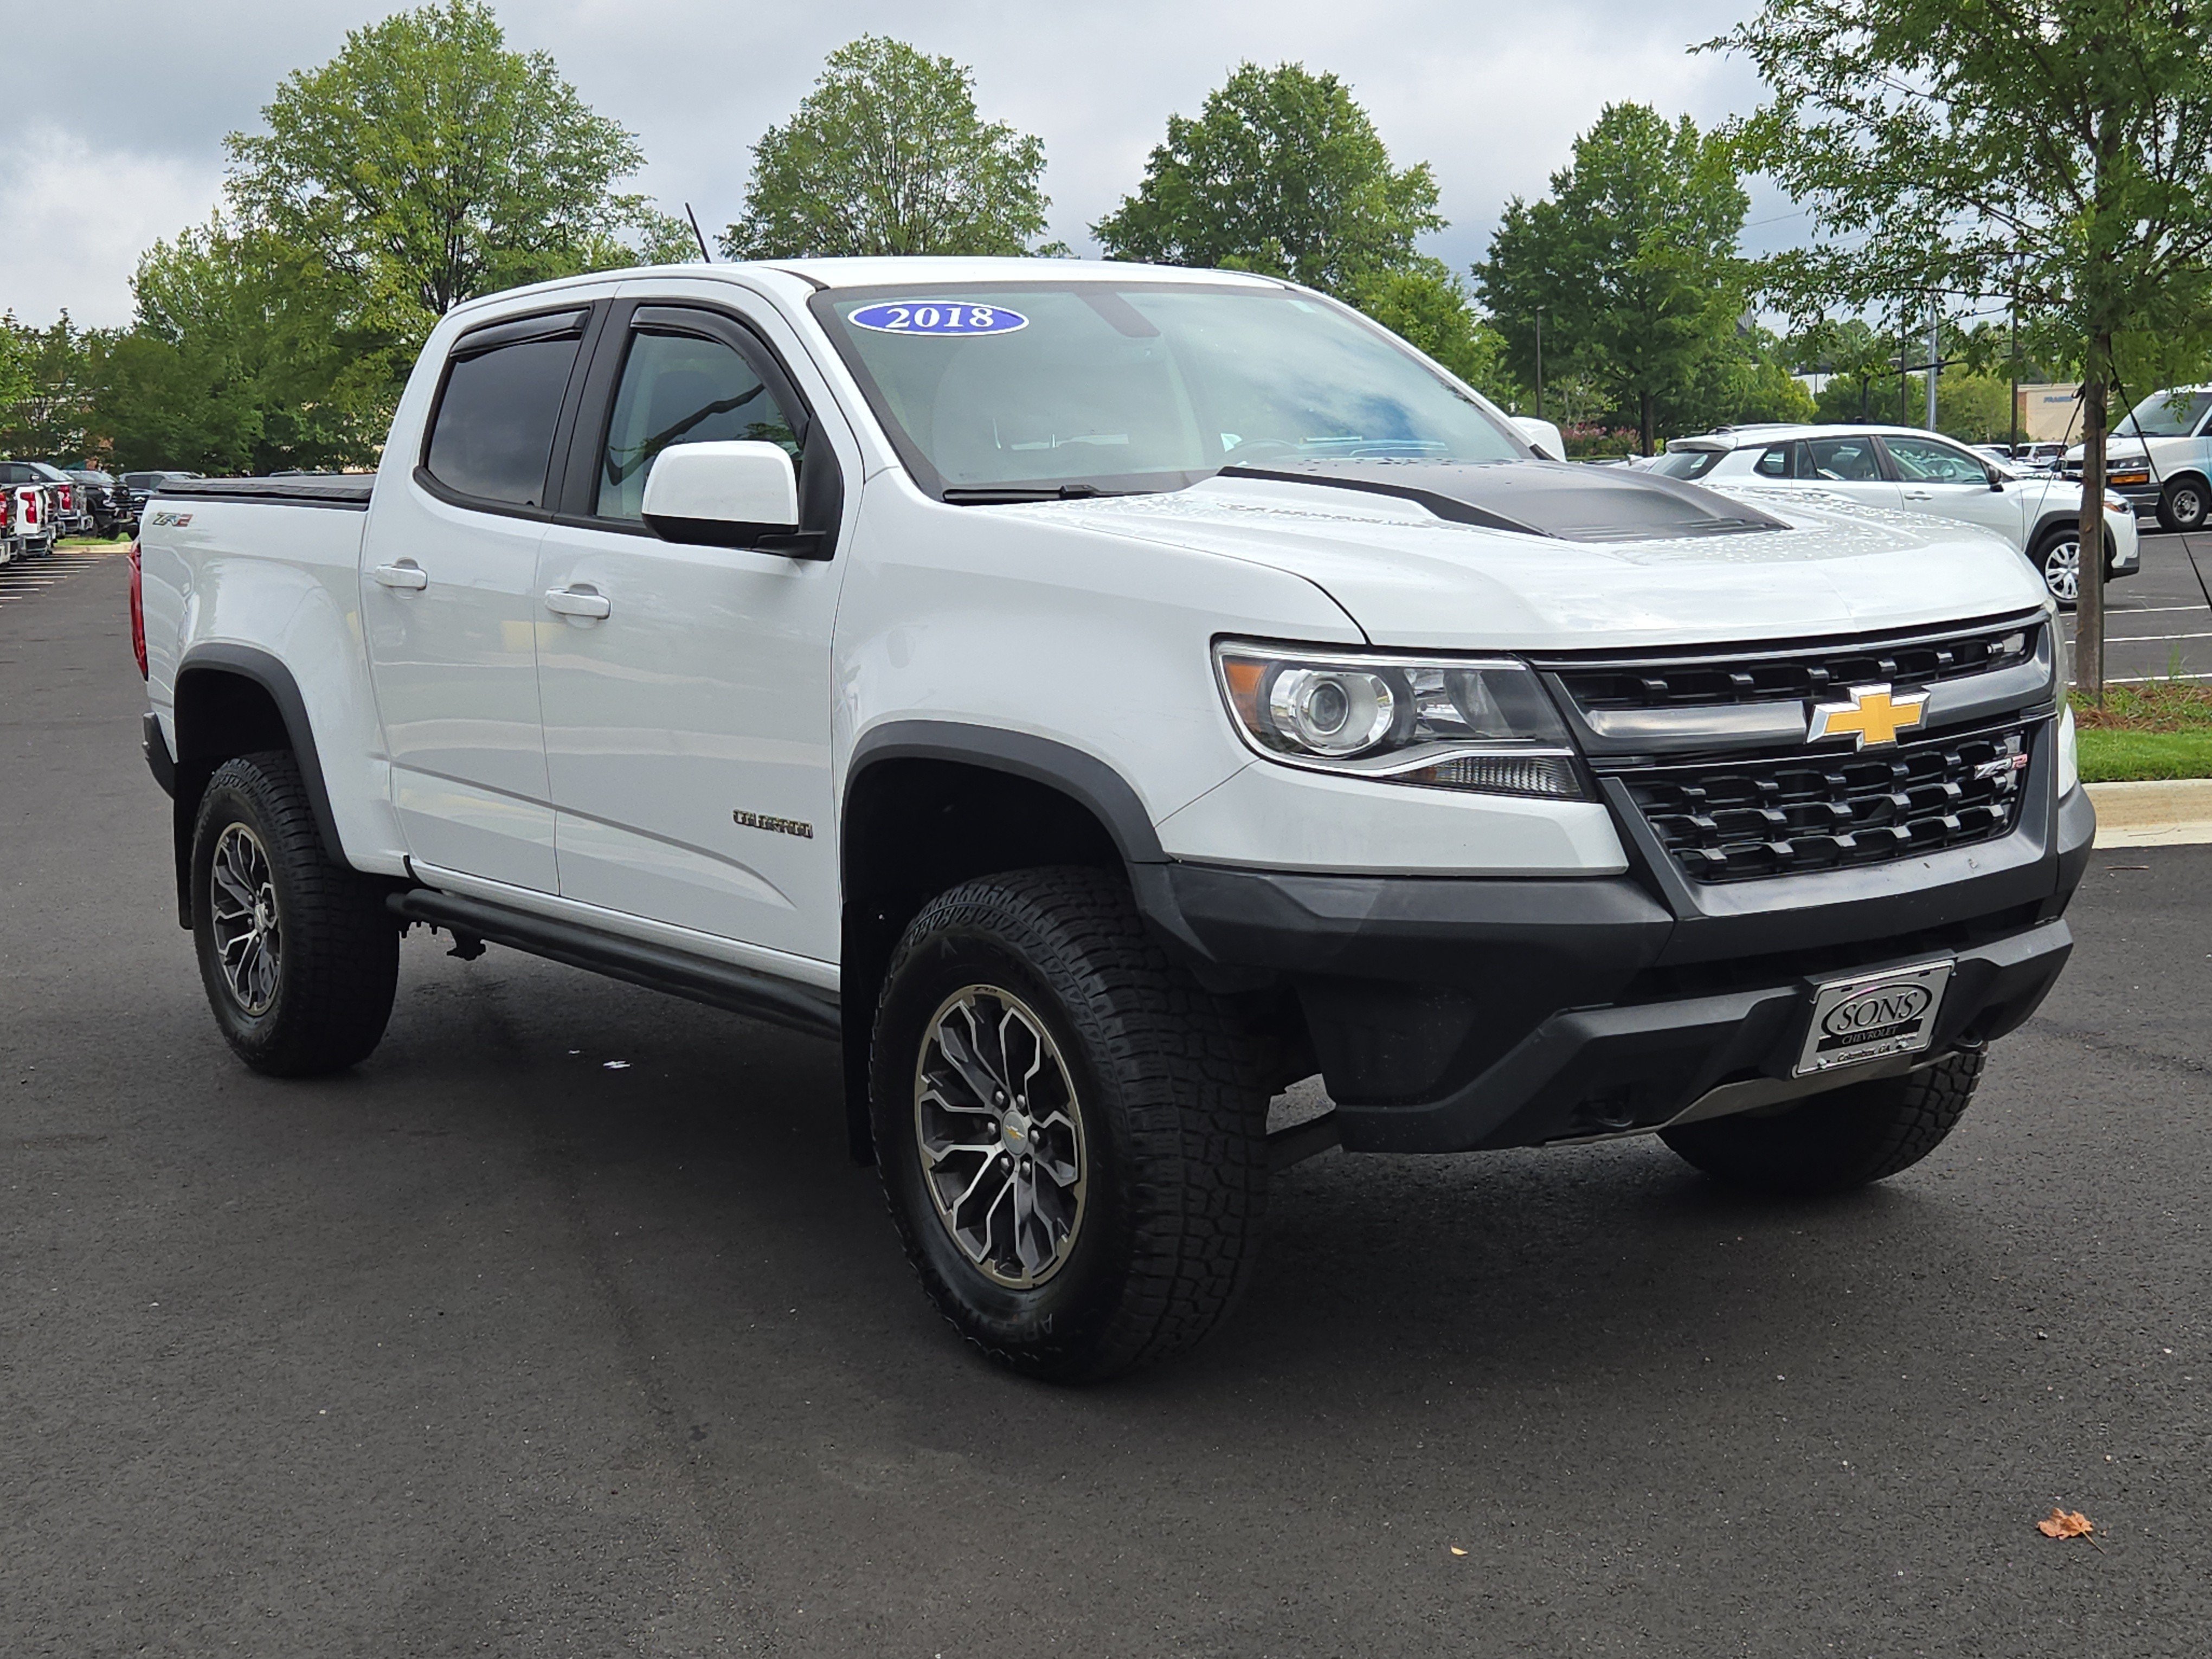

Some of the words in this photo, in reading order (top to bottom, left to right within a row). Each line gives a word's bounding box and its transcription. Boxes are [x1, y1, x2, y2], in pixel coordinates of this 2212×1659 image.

[885, 307, 994, 328] 2018
[1837, 991, 1918, 1030] SONS
[1842, 1026, 1899, 1045] CHEVROLET
